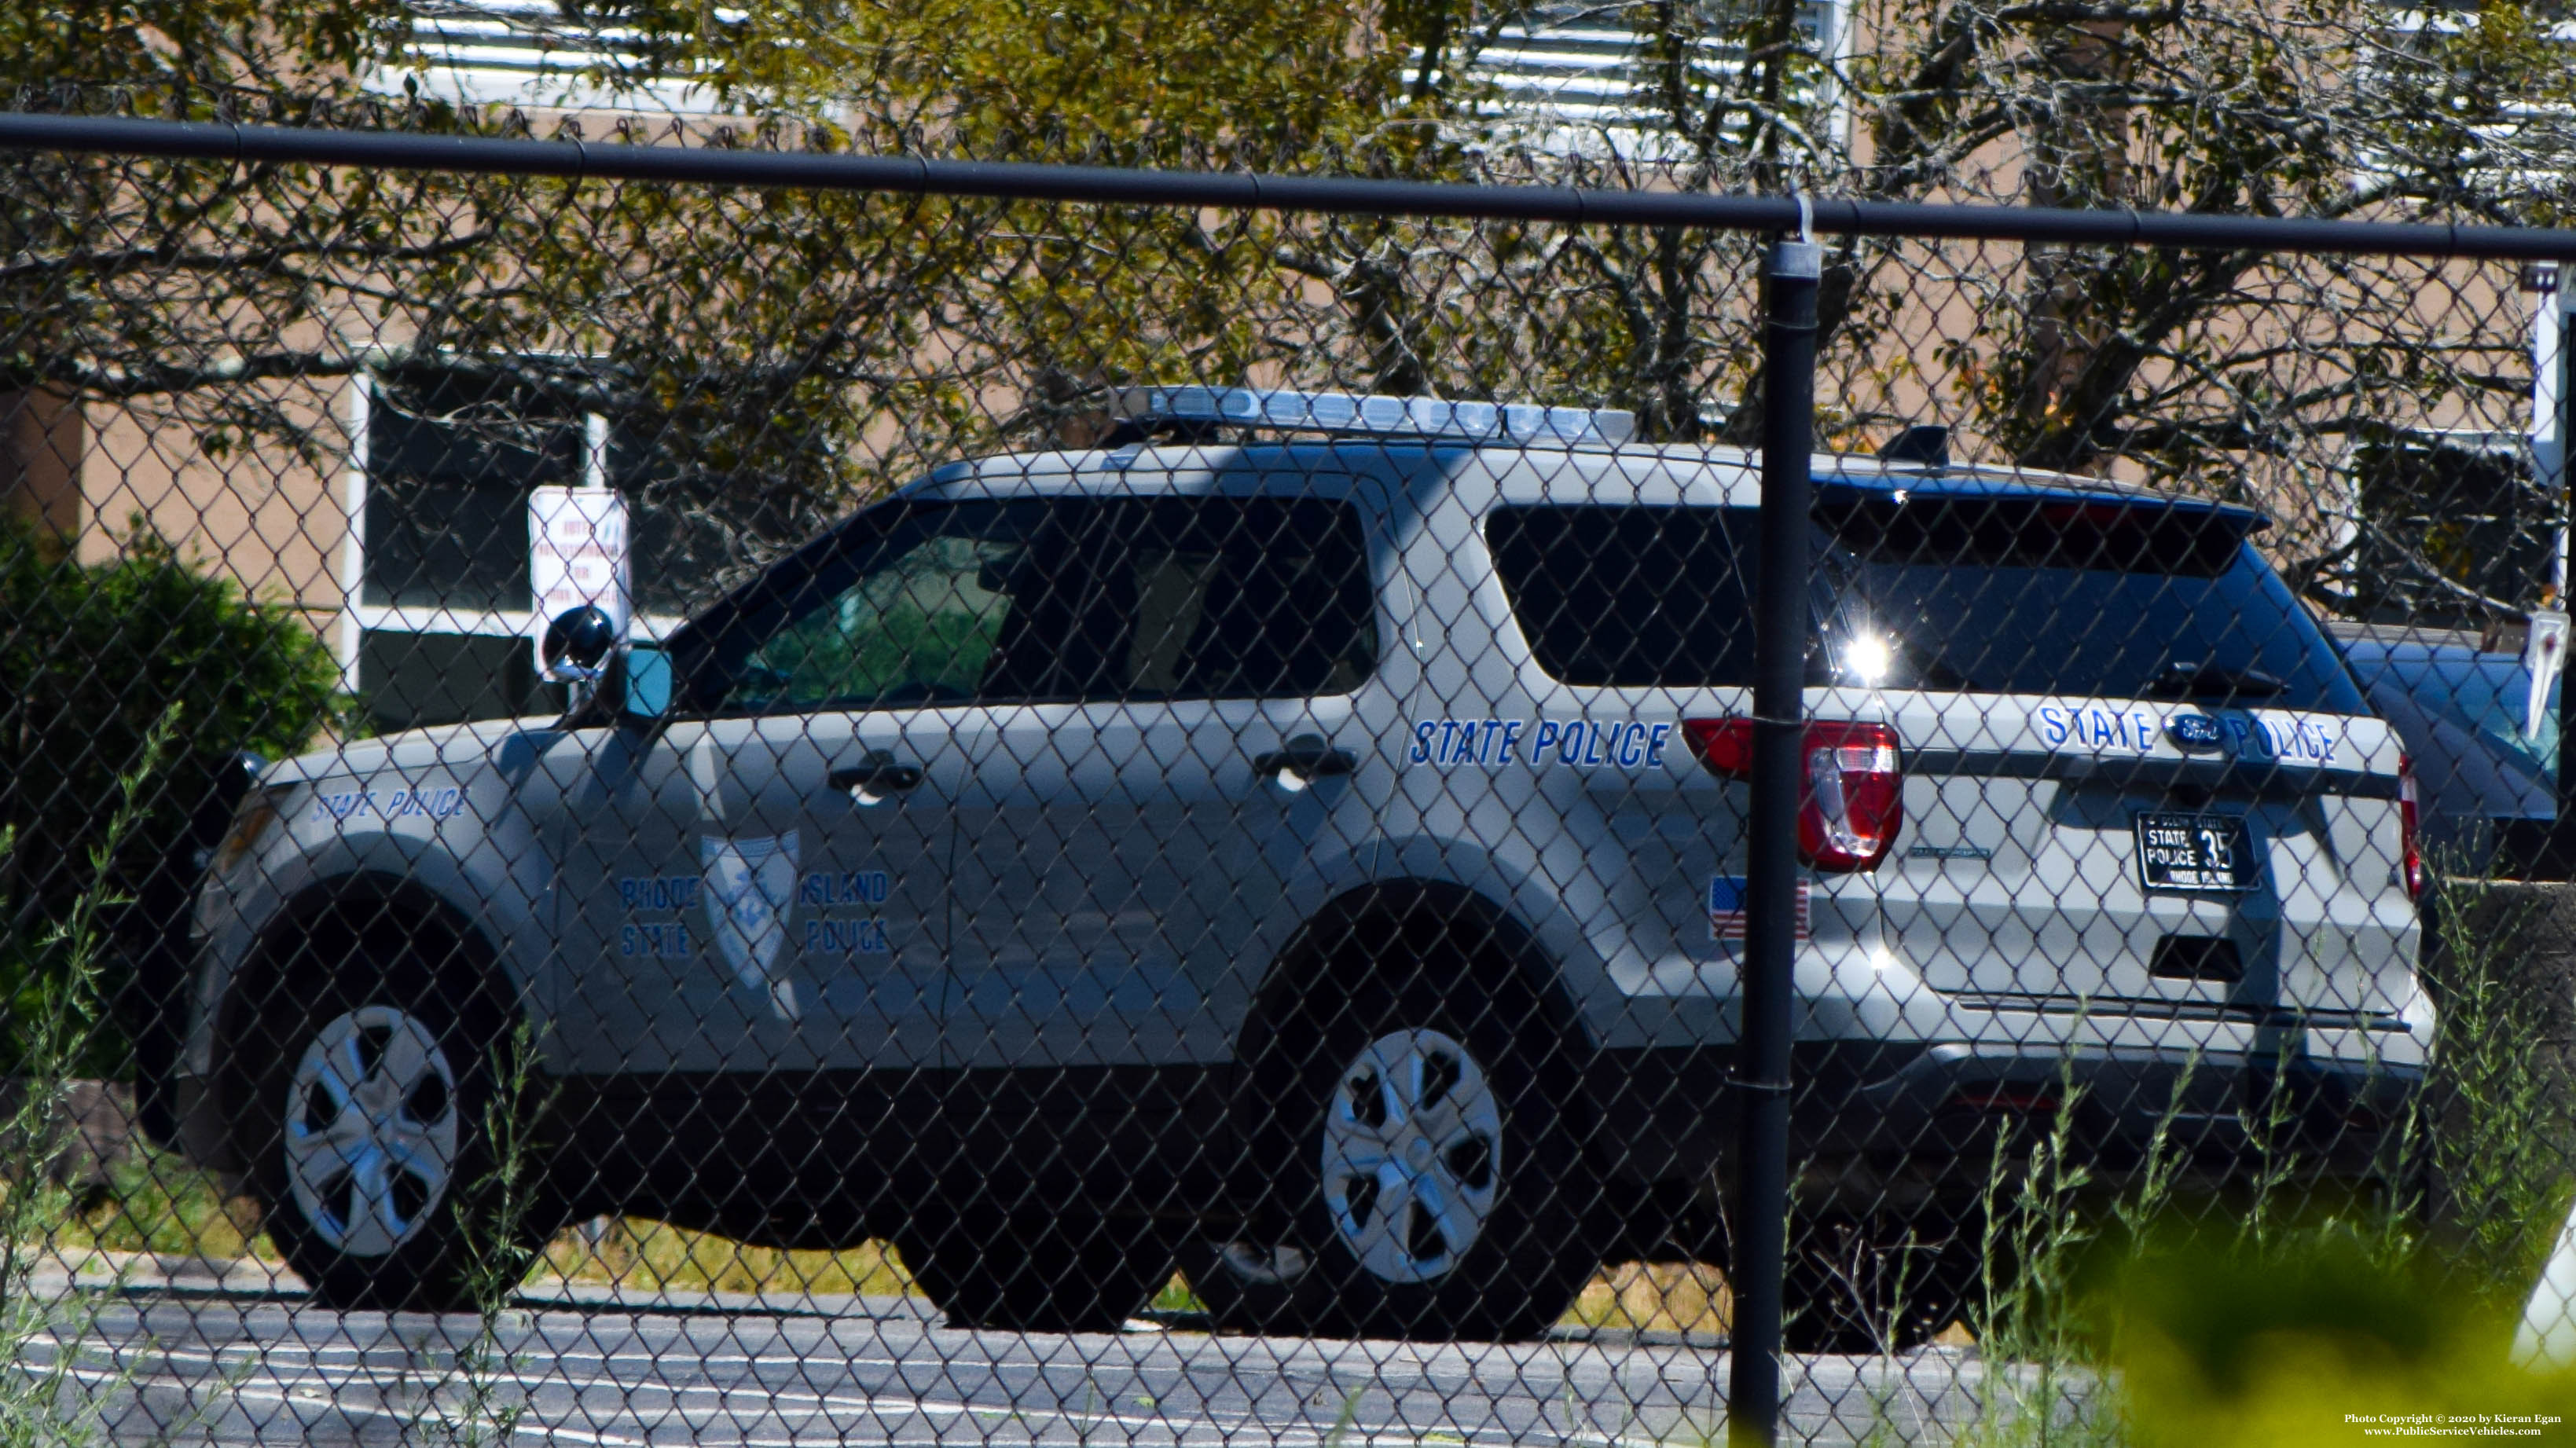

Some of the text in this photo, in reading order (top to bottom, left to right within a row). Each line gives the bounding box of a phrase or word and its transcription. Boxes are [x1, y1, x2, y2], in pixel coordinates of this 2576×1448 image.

[1409, 718, 1671, 769] STATE POLICE
[2040, 706, 2336, 764] STATE POLICE
[312, 786, 470, 822] STATE POLICE
[2147, 848, 2196, 867] POLICE
[2149, 830, 2190, 847] STATE
[2201, 829, 2233, 869] 35
[619, 871, 888, 911] RHODE ISLAND
[621, 919, 888, 957] STATE POLICE
